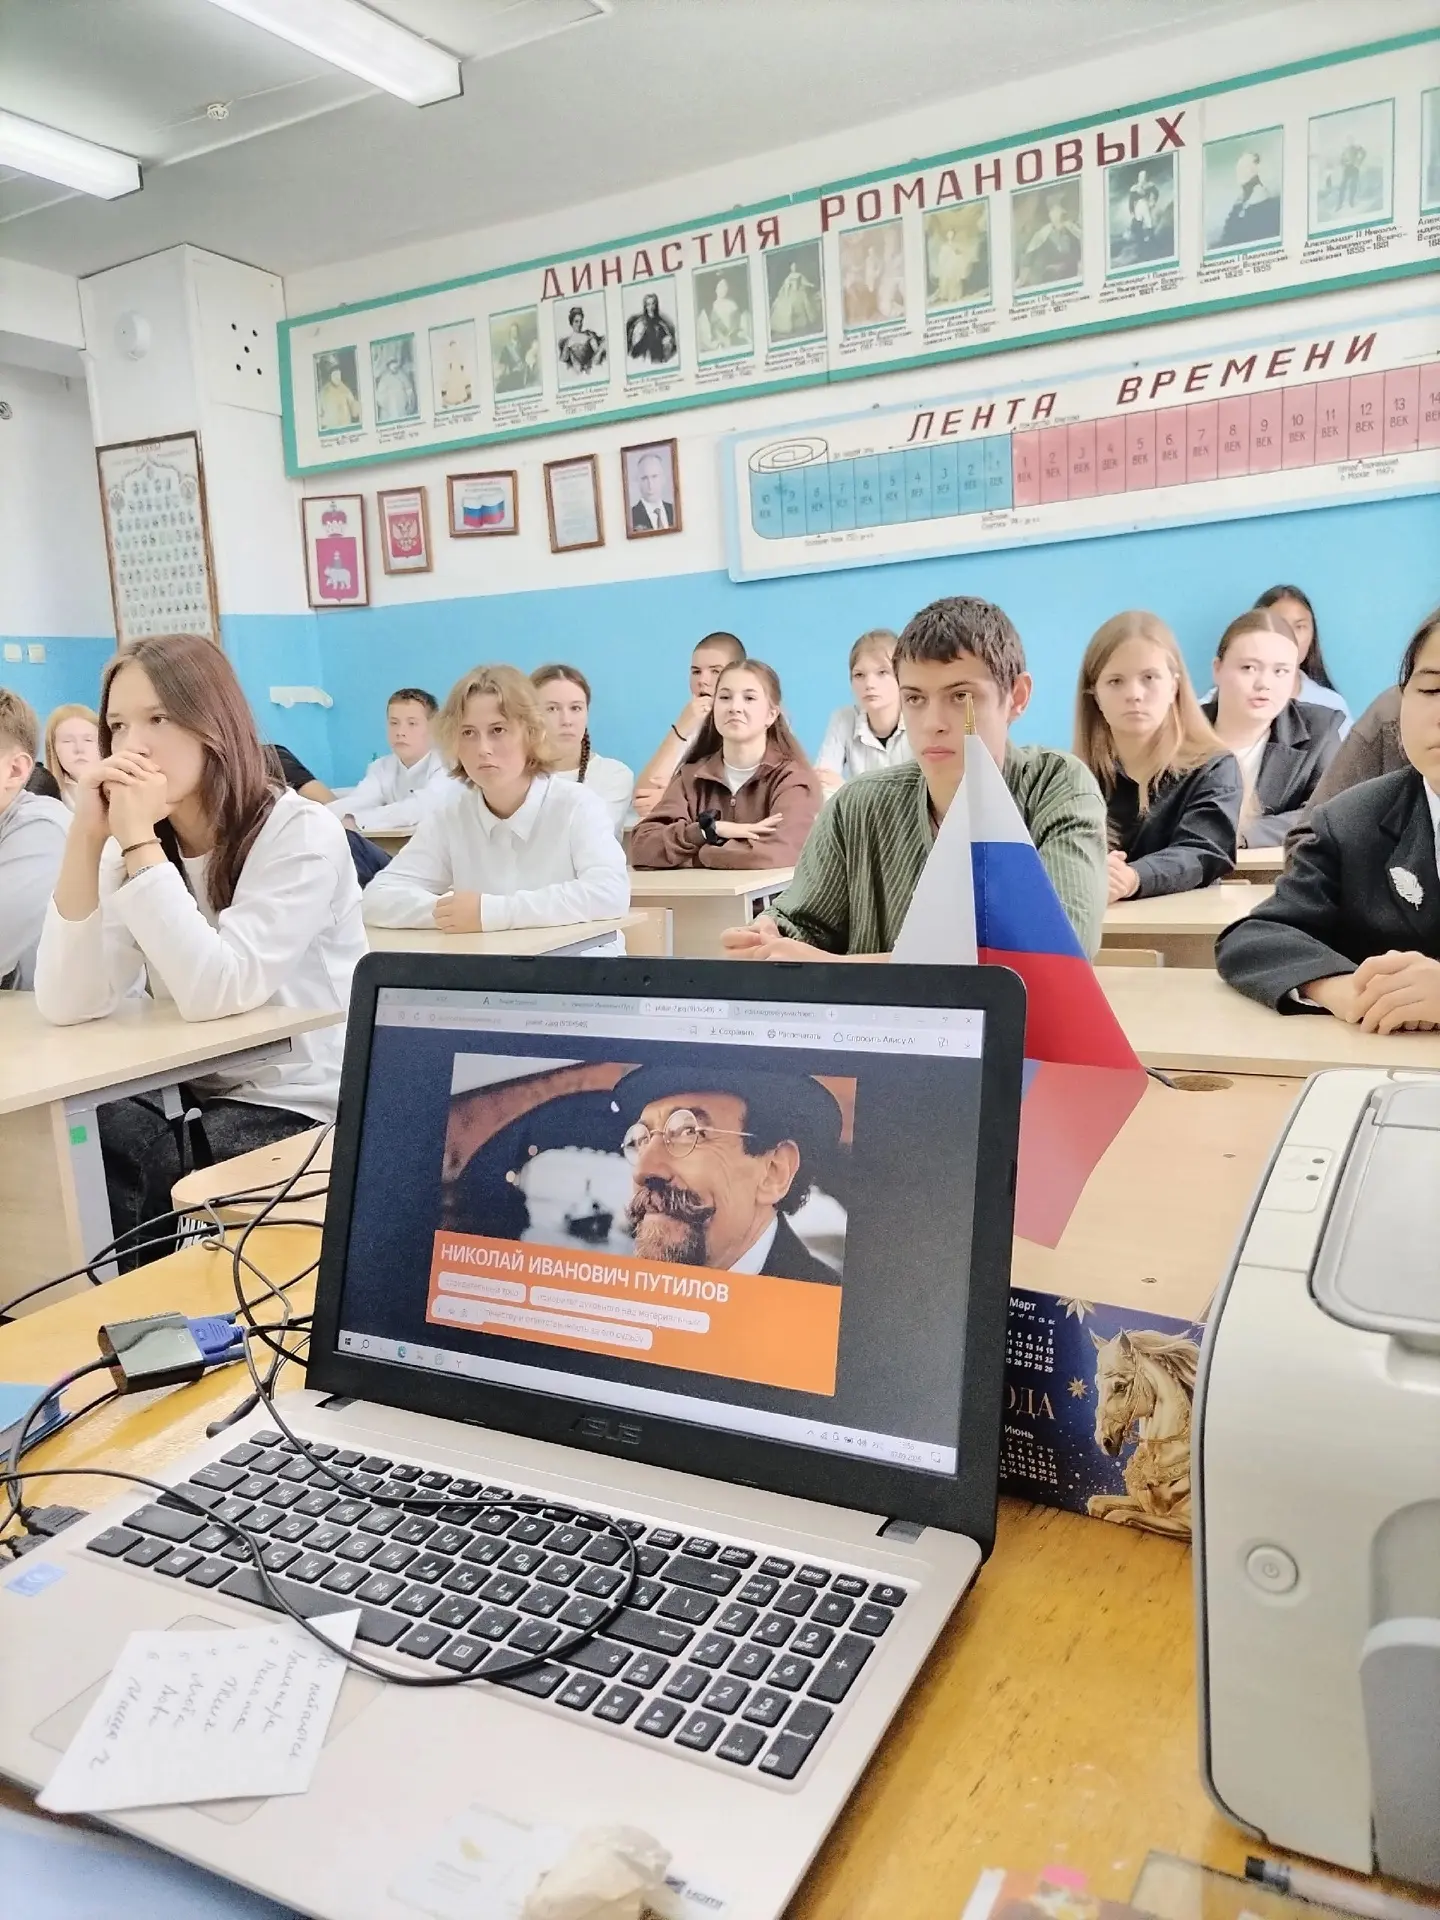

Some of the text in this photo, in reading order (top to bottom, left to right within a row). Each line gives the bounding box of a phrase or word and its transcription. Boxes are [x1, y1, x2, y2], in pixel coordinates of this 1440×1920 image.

[540, 110, 1187, 303] ДИНАСТИЯ РОМАНОВЫХ
[907, 332, 1378, 442] ЛЕНТА ВРЕМЕНИ
[1360, 402, 1373, 416] 12
[1393, 397, 1406, 411] 13
[1292, 414, 1304, 427] 10
[1326, 409, 1336, 421] 11
[1260, 419, 1268, 432] 9
[1355, 421, 1375, 433] ВЕК
[1390, 415, 1409, 428] ВЕК
[1197, 429, 1206, 441] 7
[1229, 424, 1237, 436] 8
[1321, 426, 1339, 439] ВЕК
[1137, 437, 1144, 449] 5
[1165, 433, 1173, 446] 6
[1256, 436, 1273, 448] ВЕК
[1289, 431, 1306, 443] ВЕК
[1078, 447, 1085, 459] 3
[1107, 444, 1114, 454] 4
[1192, 445, 1209, 457] ВЕК
[1224, 441, 1241, 453] ВЕК
[1049, 452, 1056, 464] 2
[1132, 453, 1149, 466] ВЕК
[1161, 449, 1178, 461] ВЕК
[1022, 456, 1028, 467] 1
[1074, 462, 1090, 473] ВЕК
[1102, 458, 1118, 470] ВЕК
[1017, 472, 1032, 483] ВЕК
[1046, 468, 1061, 479] ВЕК
[964, 479, 977, 490] ВЕК
[440, 1243, 730, 1303] НИКОЛАЙ ИВАНОВИЧ ПУТИЛОВ
[578, 1300, 620, 1313] духовного
[622, 1306, 637, 1316] над
[1009, 1297, 1037, 1312] Март
[1015, 1340, 1023, 1348] 12
[1025, 1342, 1033, 1351] 13
[1035, 1345, 1044, 1353] 14
[1046, 1347, 1054, 1355] 15
[1024, 1352, 1033, 1360] 20
[1045, 1356, 1054, 1364] 22
[1014, 1358, 1023, 1366] 26
[1034, 1363, 1043, 1371] 28
[1045, 1365, 1054, 1373] 29
[568, 1416, 643, 1445] ASUS
[1004, 1424, 1035, 1440] Июнь
[488, 1515, 501, 1523] 8
[408, 1524, 423, 1532] Y
[524, 1524, 537, 1533] 9
[442, 1534, 458, 1543] U
[560, 1534, 574, 1543] 0
[764, 1559, 788, 1570] home
[800, 1569, 824, 1580] pgup
[836, 1579, 862, 1589] pgdn
[729, 1611, 743, 1621] 7
[767, 1622, 781, 1632] 8
[806, 1632, 820, 1643] 9
[706, 1643, 720, 1653] 4
[744, 1653, 758, 1664] 5
[783, 1664, 797, 1676] 6
[682, 1674, 693, 1685] 1
[718, 1687, 734, 1699] 2
[759, 1698, 774, 1710] 3
[693, 1721, 707, 1733] 0
